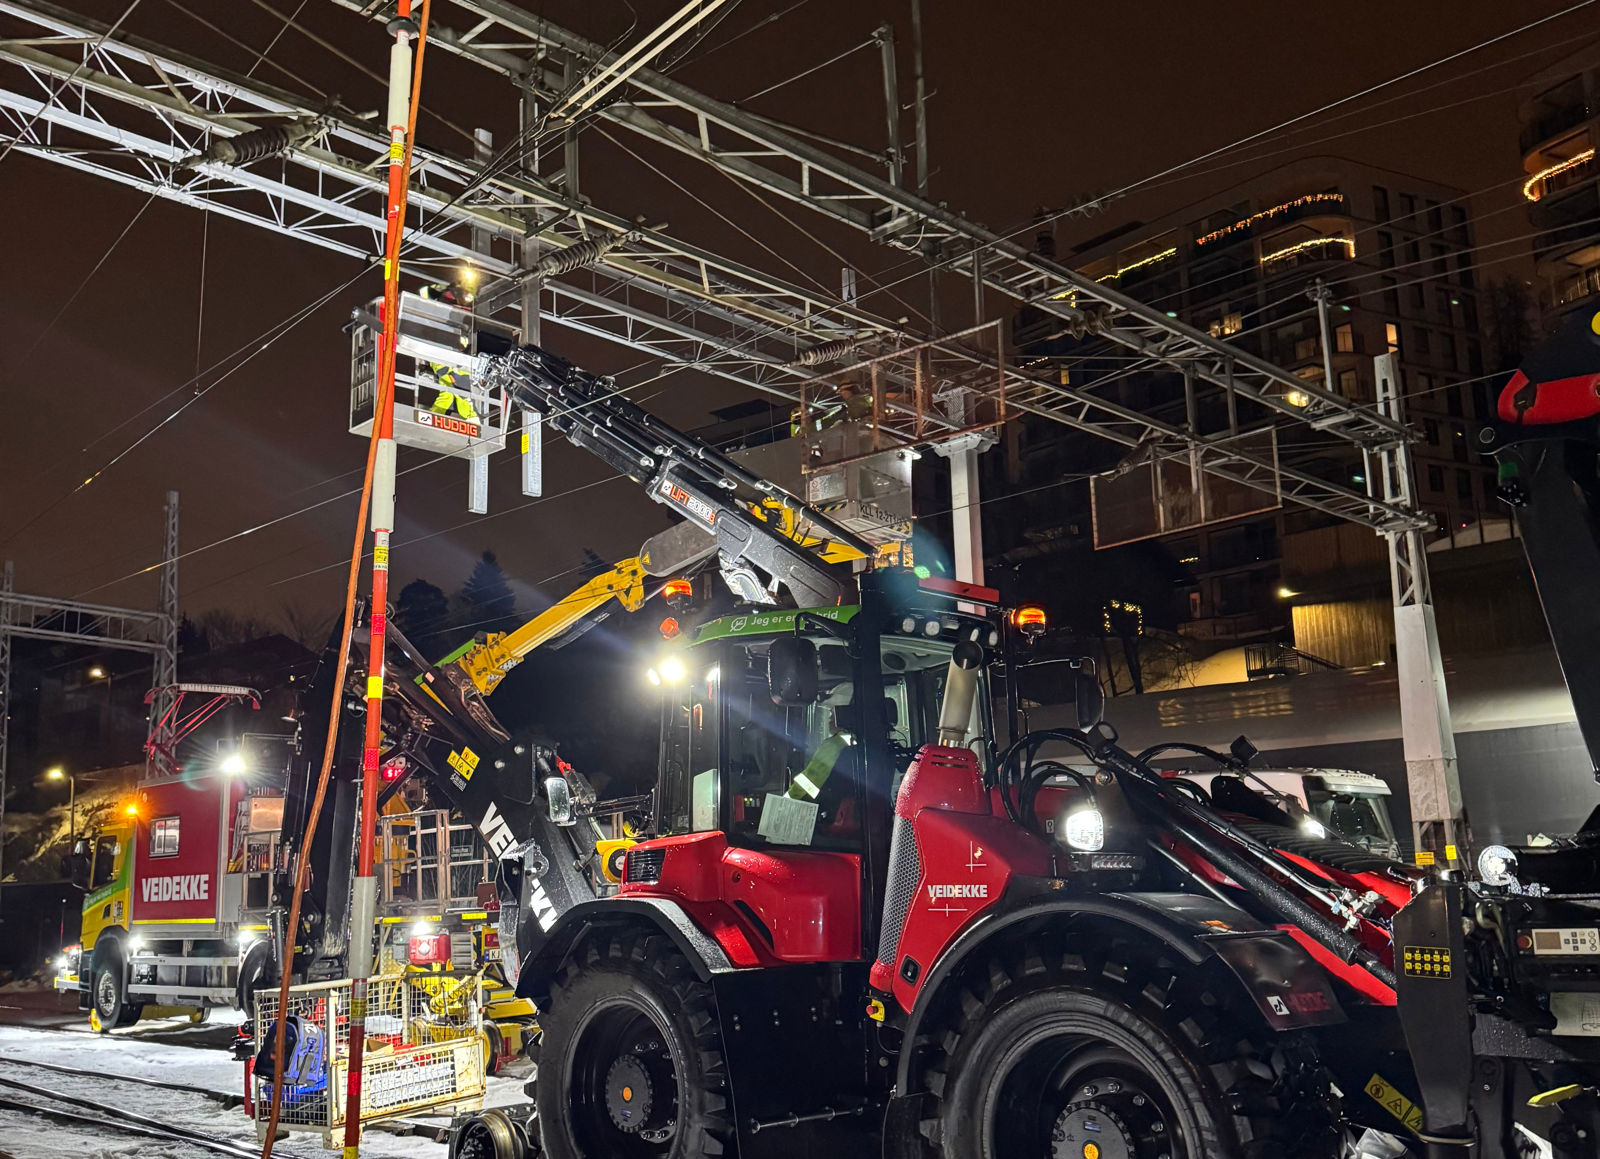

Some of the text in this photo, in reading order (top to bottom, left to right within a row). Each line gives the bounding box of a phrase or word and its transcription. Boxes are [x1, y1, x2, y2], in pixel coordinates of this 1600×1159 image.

[433, 415, 478, 437] HUDDIG
[670, 484, 690, 507] LIFT
[751, 616, 769, 627] Jeg
[772, 614, 782, 623] er
[141, 874, 209, 902] VEIDEKKE
[927, 884, 988, 898] VEIDEKKE
